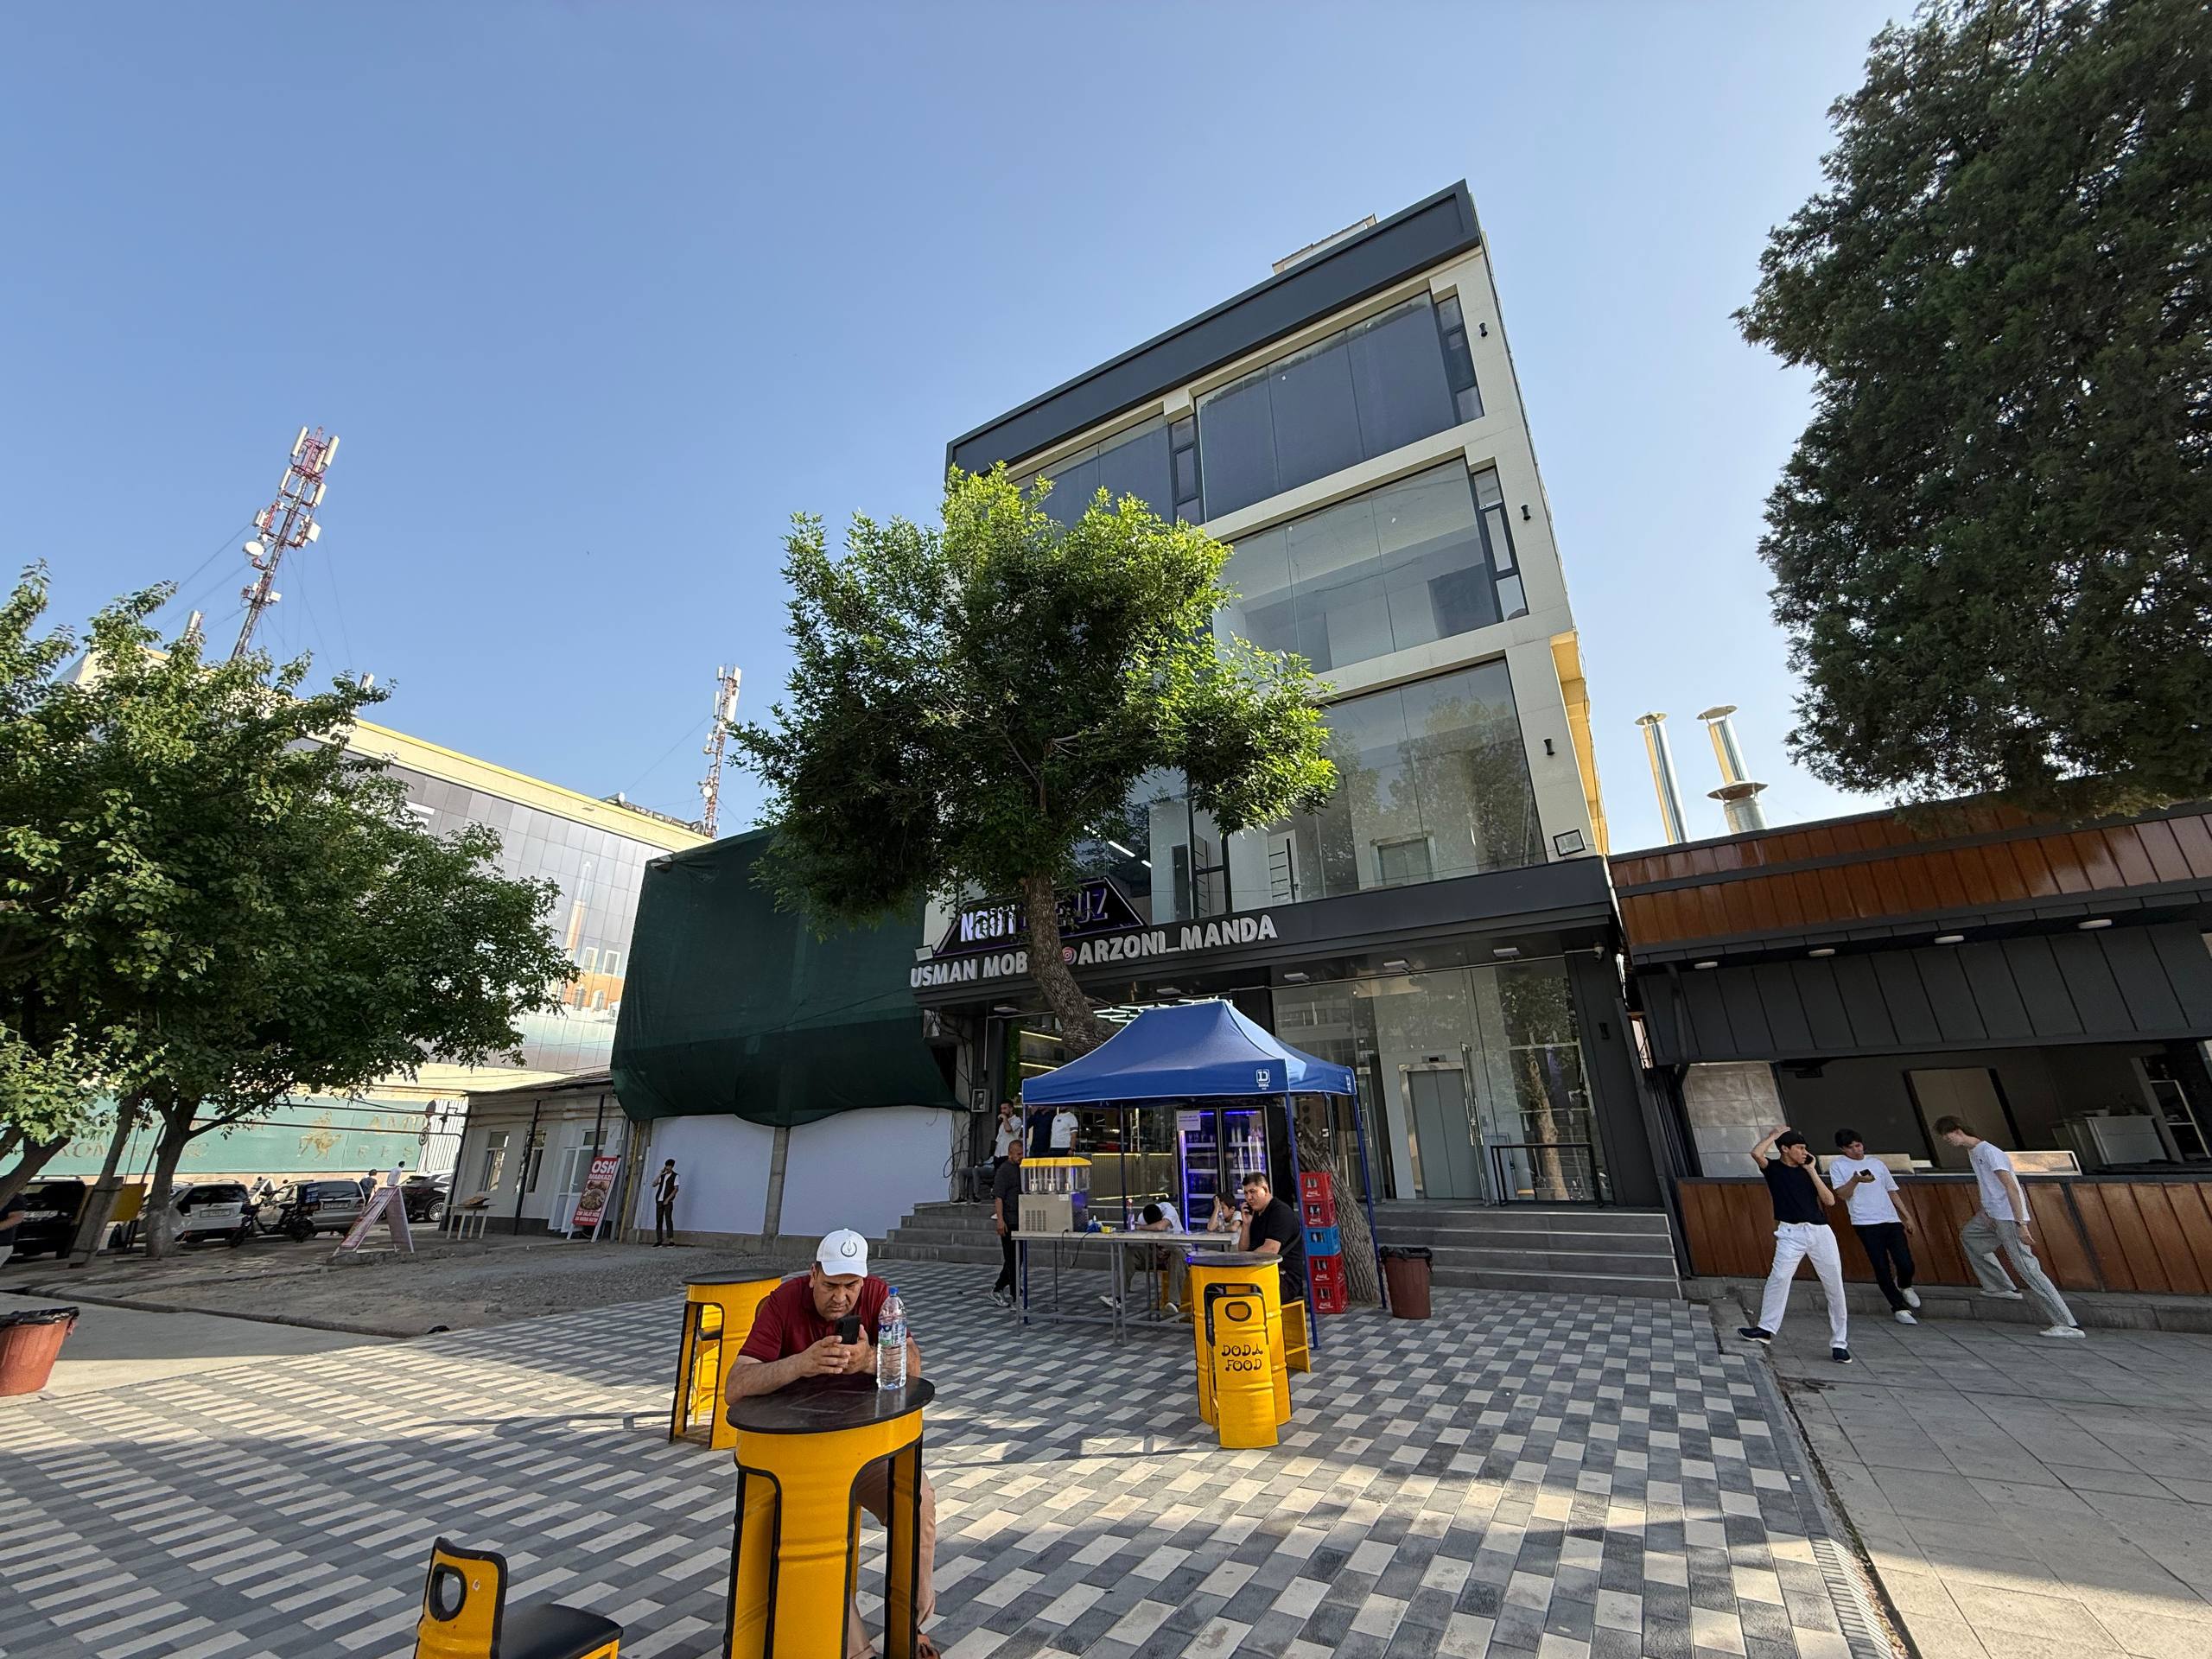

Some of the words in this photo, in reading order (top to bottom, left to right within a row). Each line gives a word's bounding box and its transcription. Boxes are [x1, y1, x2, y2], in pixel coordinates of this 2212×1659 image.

[910, 958, 978, 988] USMAN
[982, 950, 1029, 978] MOB
[1077, 914, 1279, 965] ARZONI_MANDA
[591, 1160, 616, 1173] OSH
[1221, 1343, 1263, 1357] DODA
[1225, 1358, 1262, 1372] FOOD
